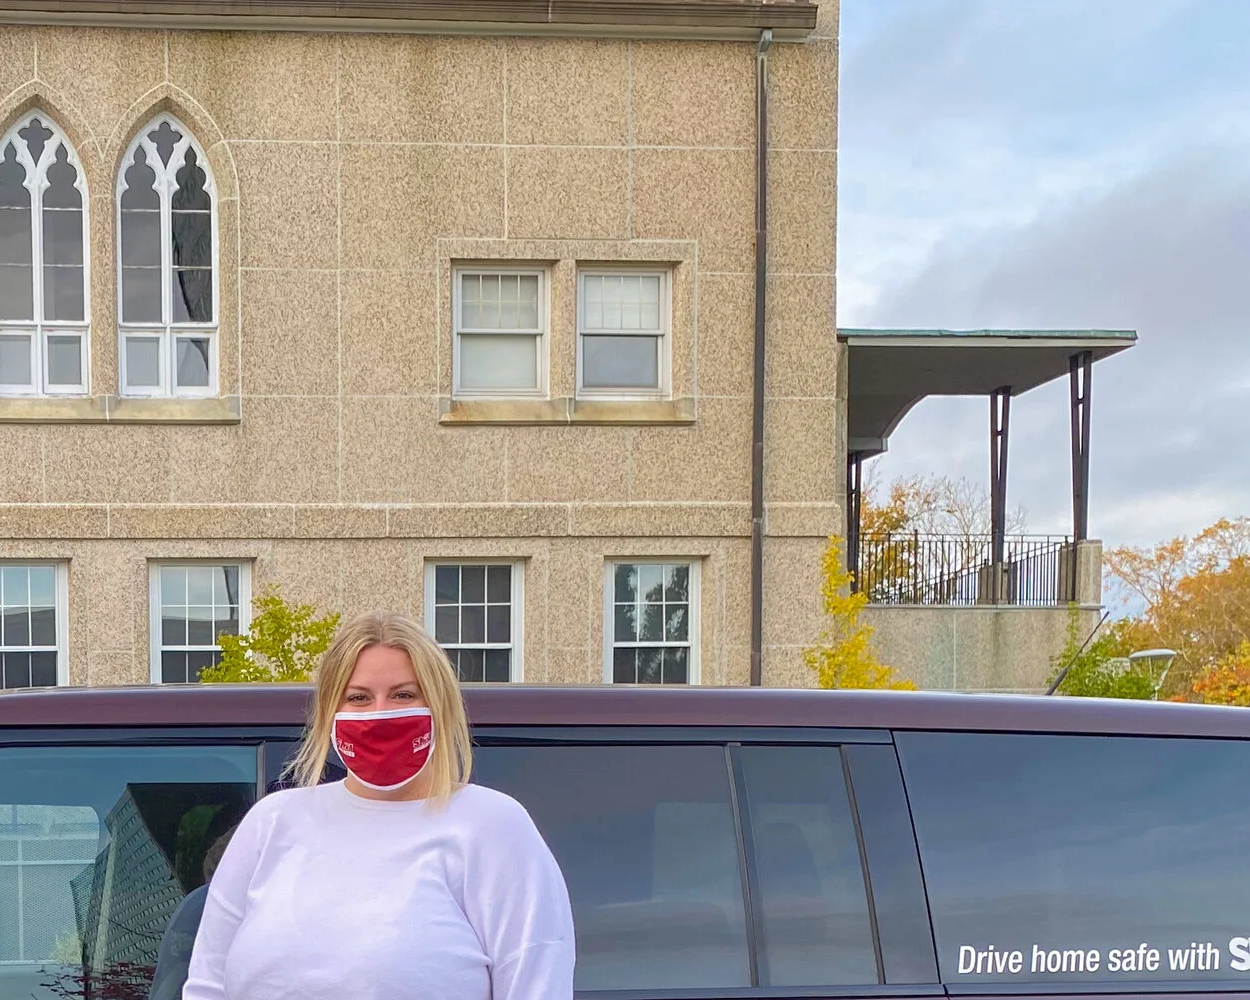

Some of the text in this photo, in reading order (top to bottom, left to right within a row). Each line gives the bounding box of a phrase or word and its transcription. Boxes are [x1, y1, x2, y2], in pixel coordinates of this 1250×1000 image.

[958, 936, 1250, 974] Drive home safe with S
